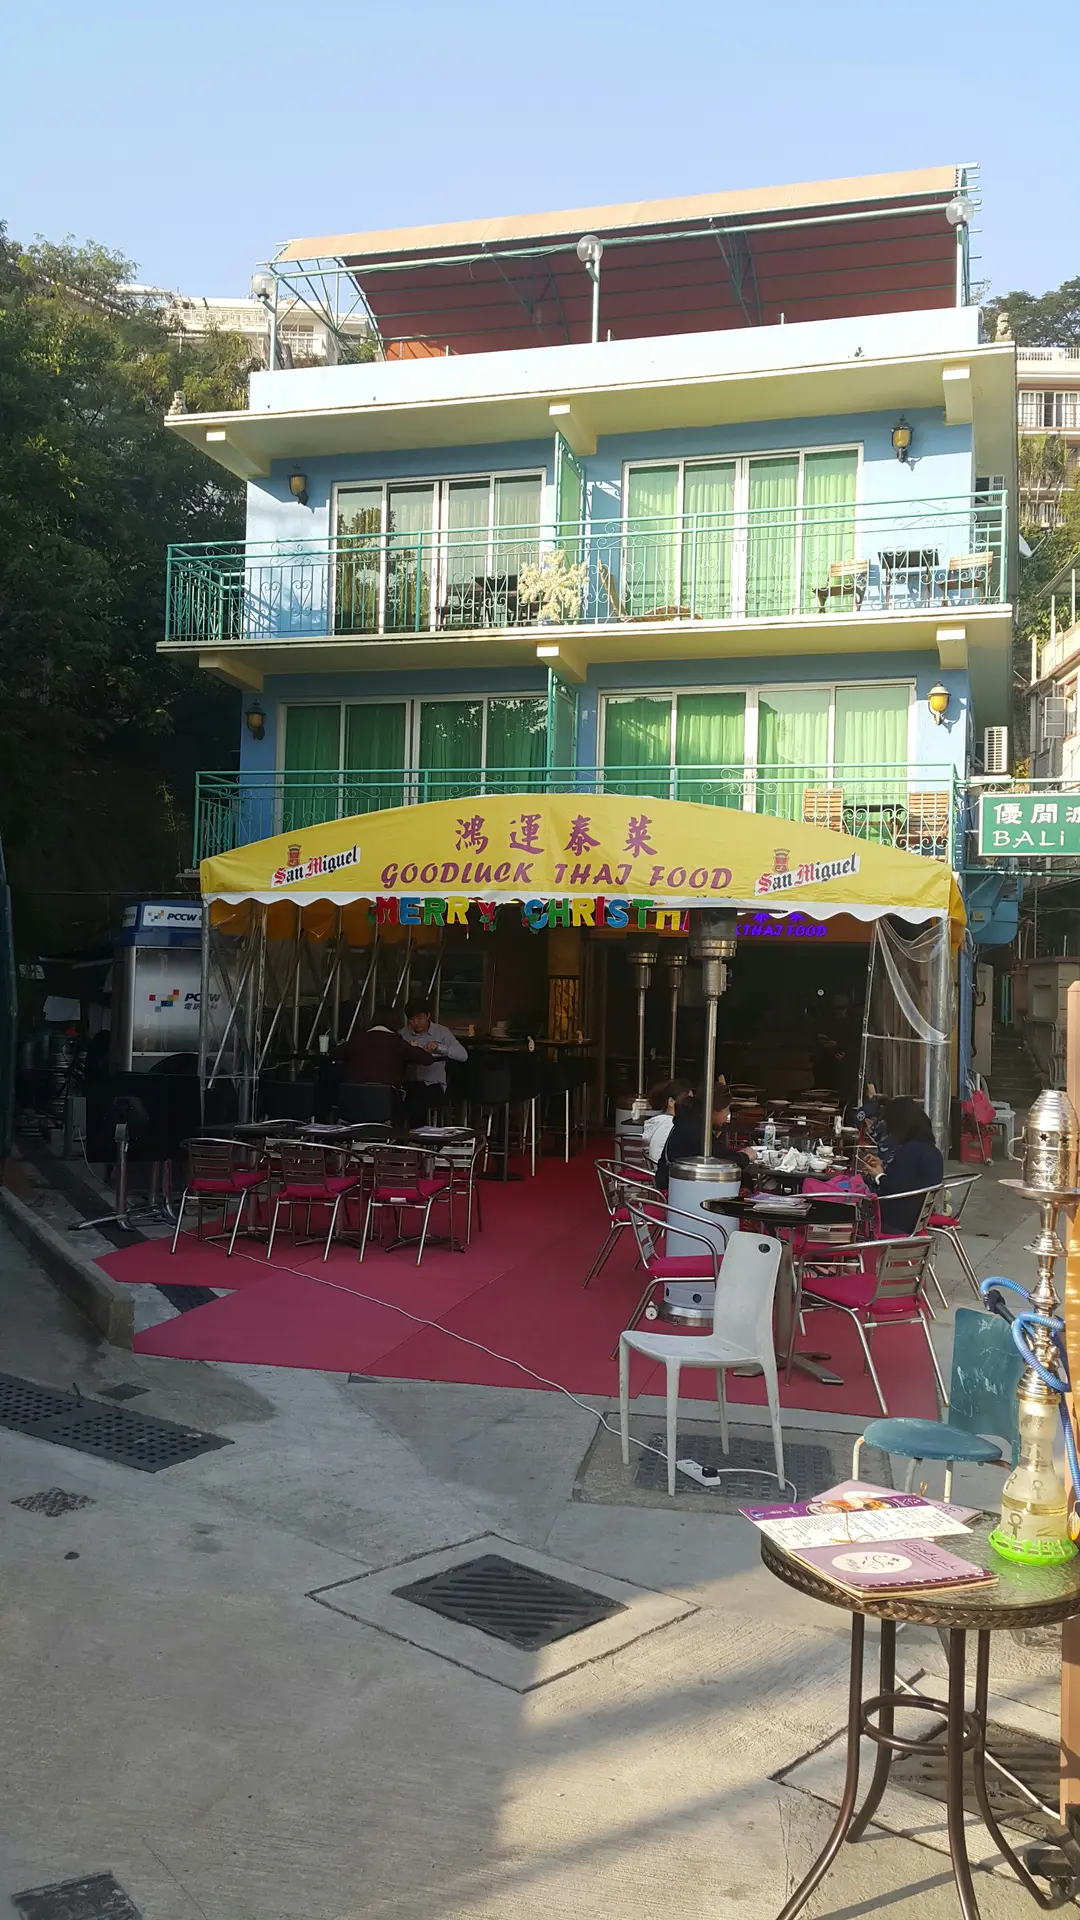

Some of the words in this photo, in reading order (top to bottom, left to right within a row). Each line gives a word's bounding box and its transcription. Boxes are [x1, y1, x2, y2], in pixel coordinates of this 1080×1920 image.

[454, 813, 659, 858] 鴻運泰菜
[273, 866, 304, 886] San
[304, 843, 358, 877] Miguel
[380, 861, 535, 889] GOODLUCK
[649, 866, 733, 890] FOOD
[757, 872, 793, 894] San
[793, 851, 857, 887] Miguel
[167, 913, 197, 922] PCCW
[374, 896, 498, 932] MERRY
[520, 895, 690, 934] CHRISTM
[786, 925, 828, 937] FOOD
[184, 993, 220, 1002] PCW
